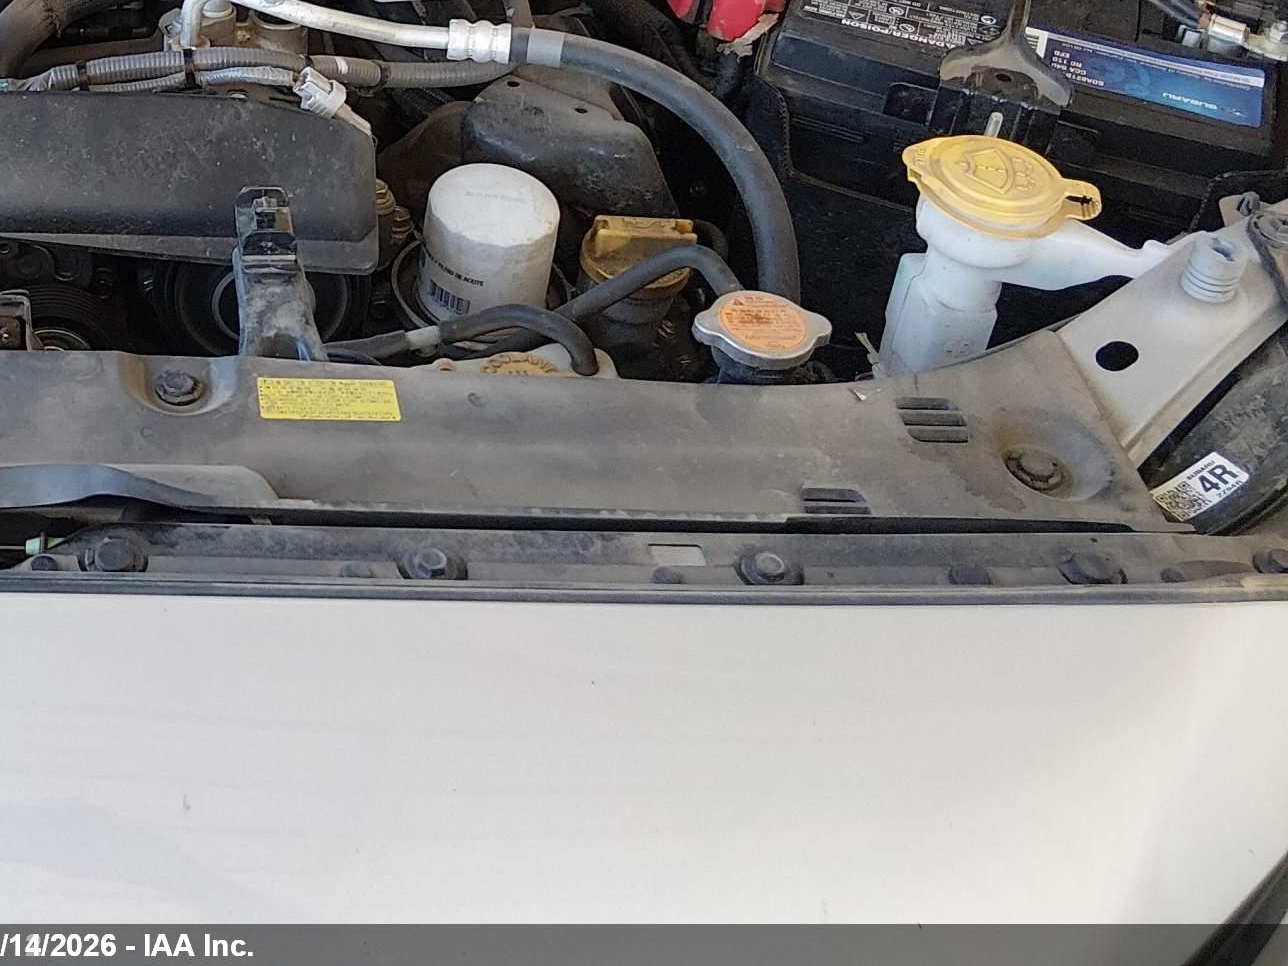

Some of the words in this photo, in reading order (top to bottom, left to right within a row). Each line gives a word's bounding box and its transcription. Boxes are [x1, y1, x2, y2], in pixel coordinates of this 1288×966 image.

[841, 18, 946, 47] DANGER/POISON
[1162, 91, 1219, 111] SUBARU
[463, 277, 484, 287] ACEITE
[1198, 464, 1239, 493] 4R
